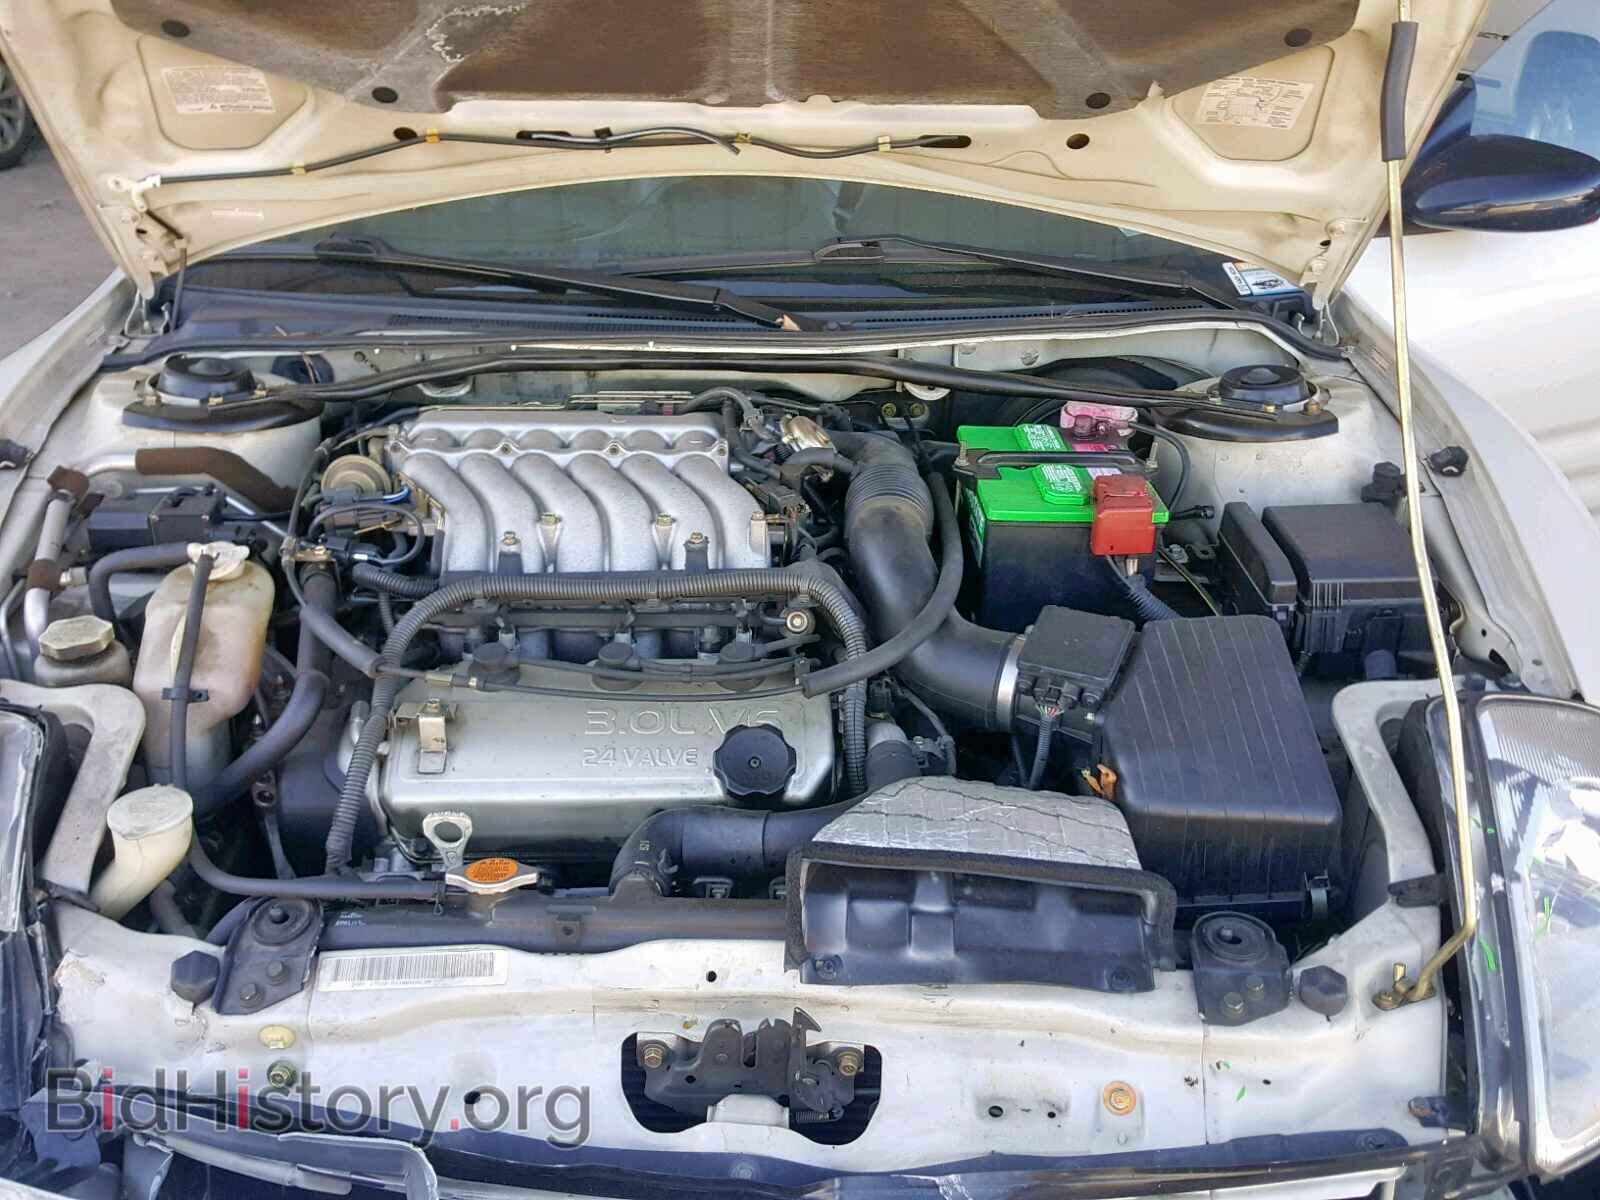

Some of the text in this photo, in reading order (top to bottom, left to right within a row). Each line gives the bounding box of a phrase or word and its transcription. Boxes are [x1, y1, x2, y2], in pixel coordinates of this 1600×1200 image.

[584, 707, 696, 736] 3.0L
[583, 748, 698, 768] 24 VALVE
